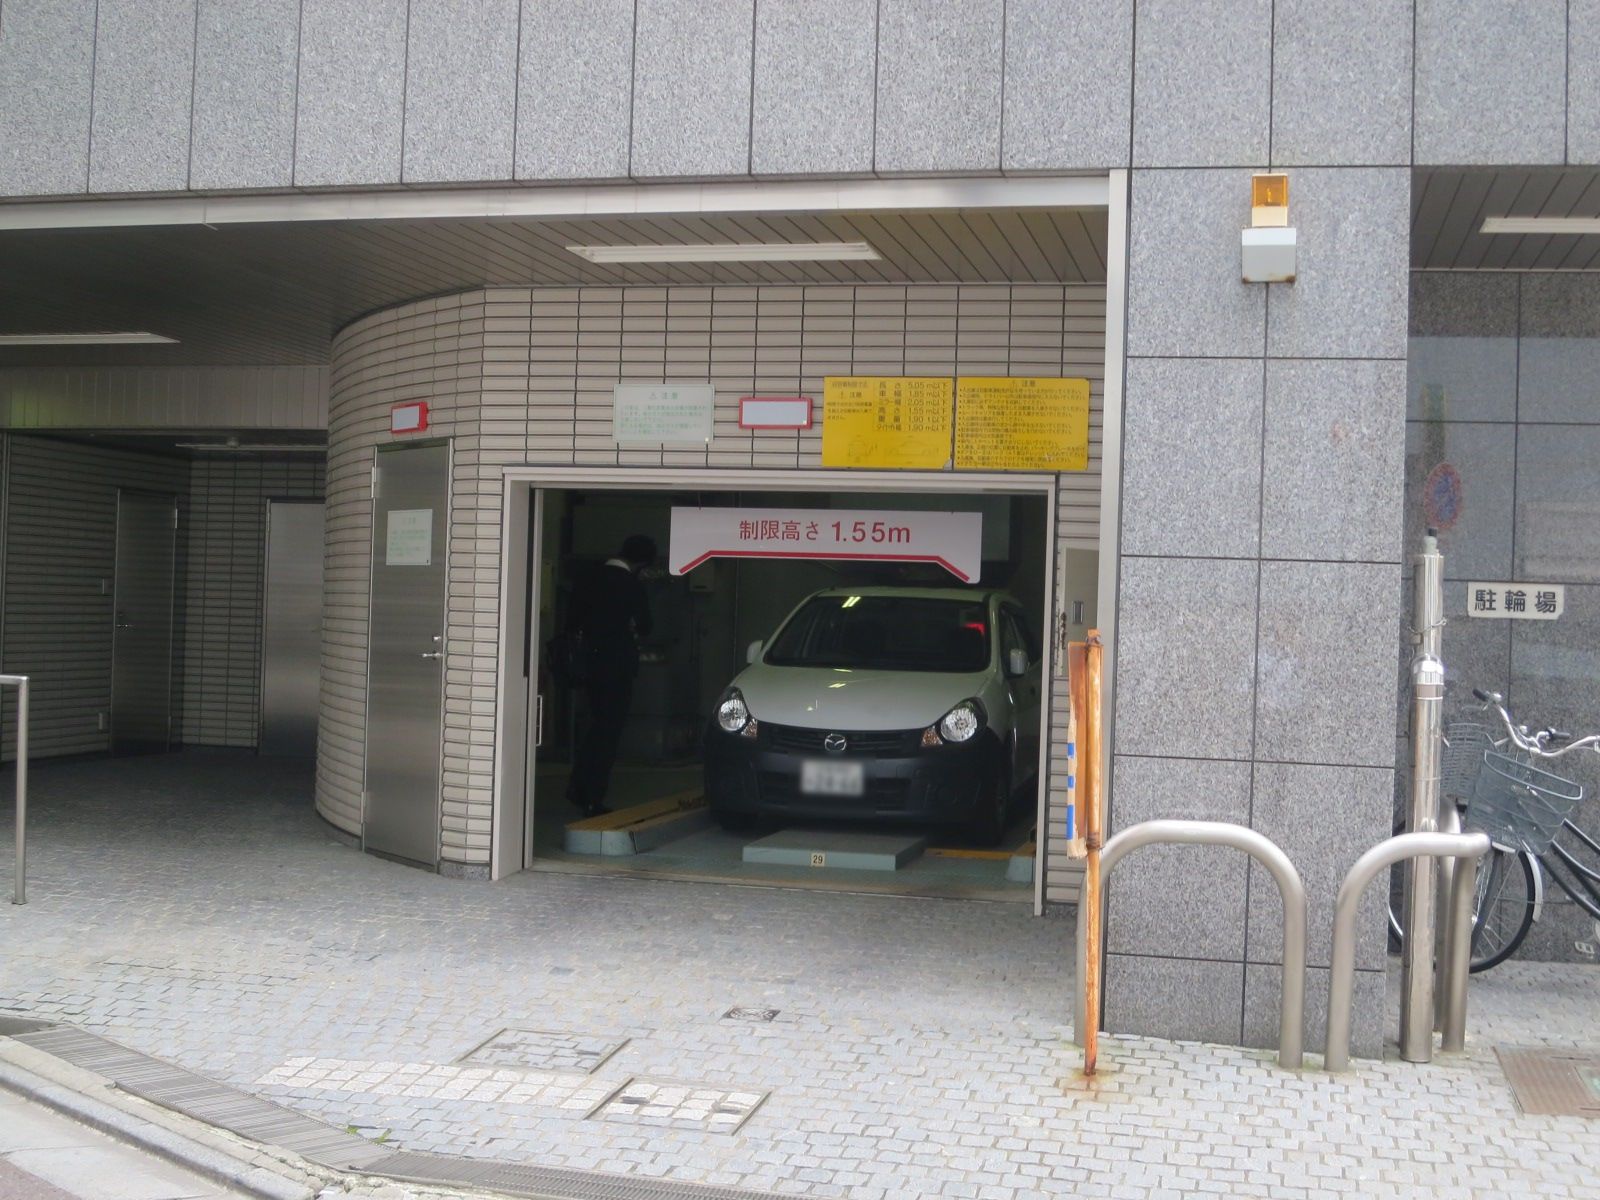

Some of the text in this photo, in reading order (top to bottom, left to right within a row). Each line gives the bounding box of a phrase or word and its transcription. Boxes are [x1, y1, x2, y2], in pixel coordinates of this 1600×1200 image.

[738, 520, 911, 543] 制限高さ 1.55m
[1474, 589, 1557, 613] 駐輪場
[813, 854, 823, 864] 29
